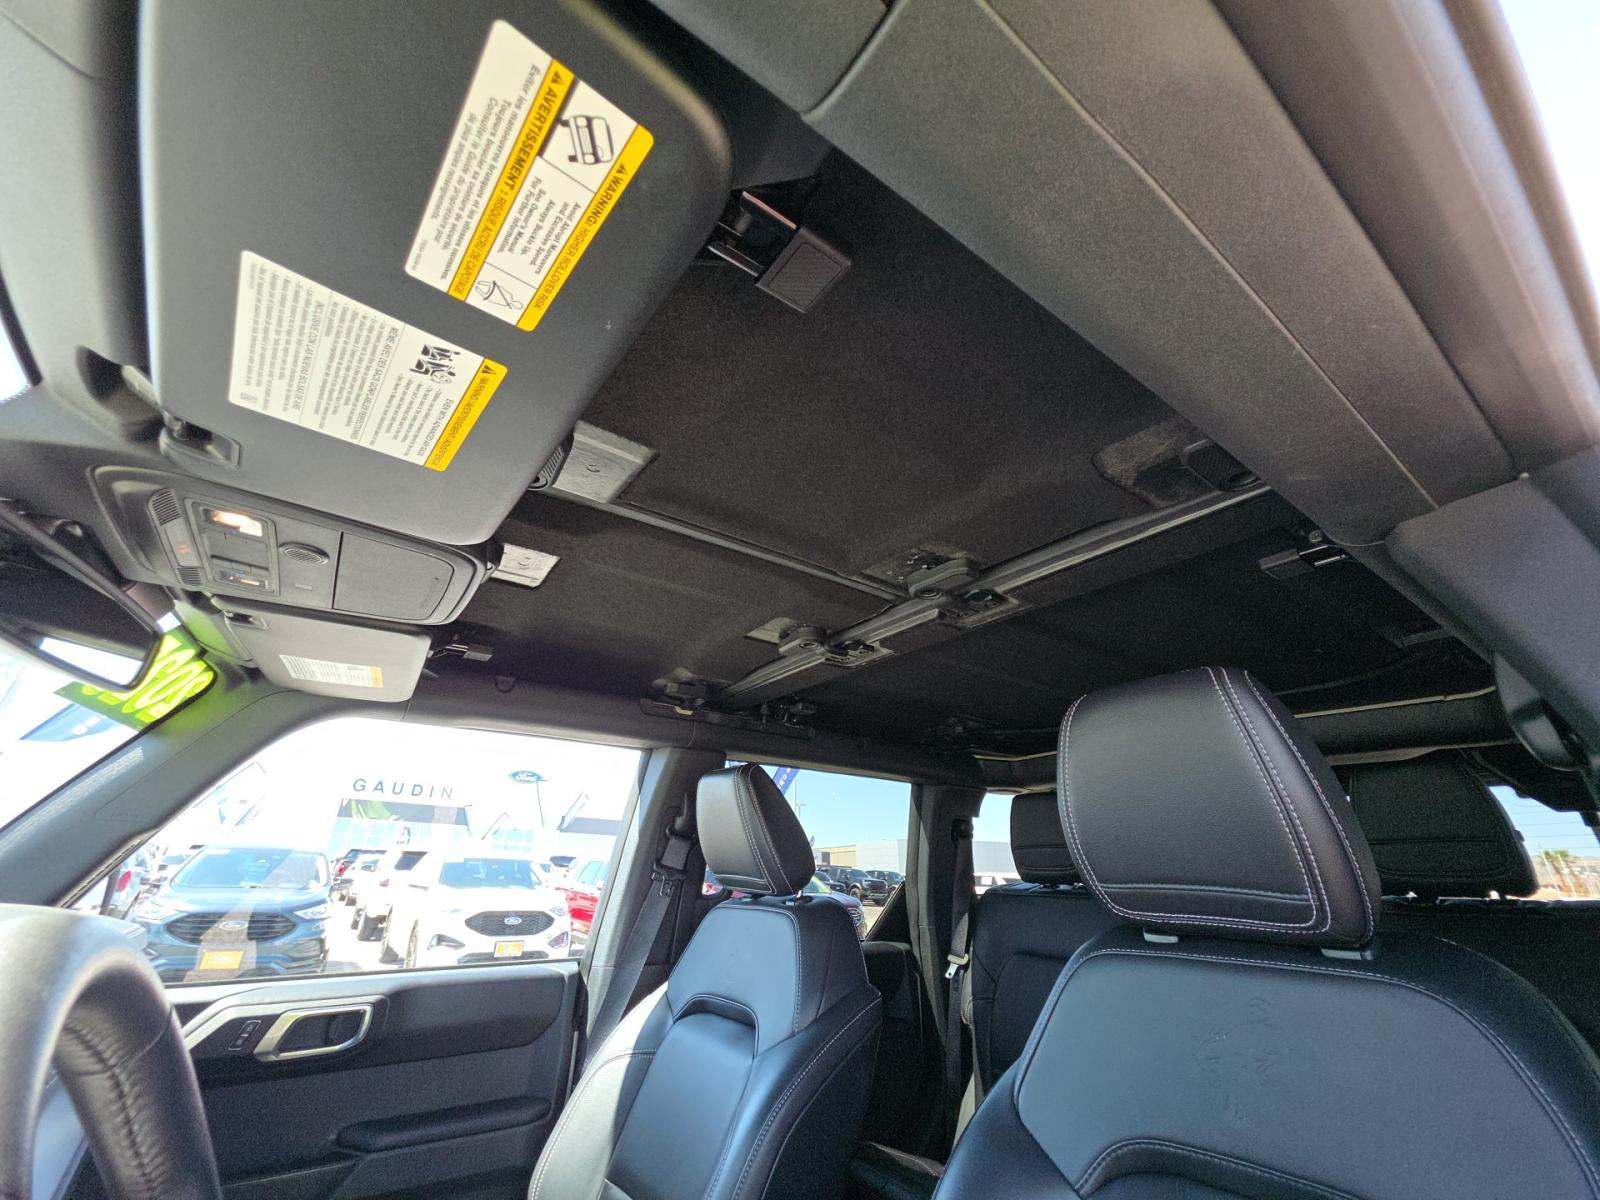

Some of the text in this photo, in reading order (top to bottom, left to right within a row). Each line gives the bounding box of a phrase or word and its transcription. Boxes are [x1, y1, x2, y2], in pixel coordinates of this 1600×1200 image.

[475, 97, 499, 141] Consulter
[489, 99, 512, 138] Toujours
[476, 138, 495, 170] boucler
[504, 86, 557, 191] AVERTISSEMENT
[461, 151, 477, 175] Guide
[486, 195, 507, 226] RISQUE
[497, 176, 543, 253] For Further Information.
[507, 188, 546, 254] See Owner's Manual
[538, 199, 556, 223] Always
[474, 224, 493, 251] ACCRU
[527, 223, 543, 245] Buckle
[529, 201, 570, 266] and Excessive Speed.
[533, 176, 623, 310] WARNING: HIGHER ROLLOVER RISK
[534, 202, 581, 275] Avoid Abrupt Maneuvers
[469, 250, 481, 262] DE
[454, 260, 476, 295] CAPOTAGE
[352, 778, 454, 799] GAUDIN
